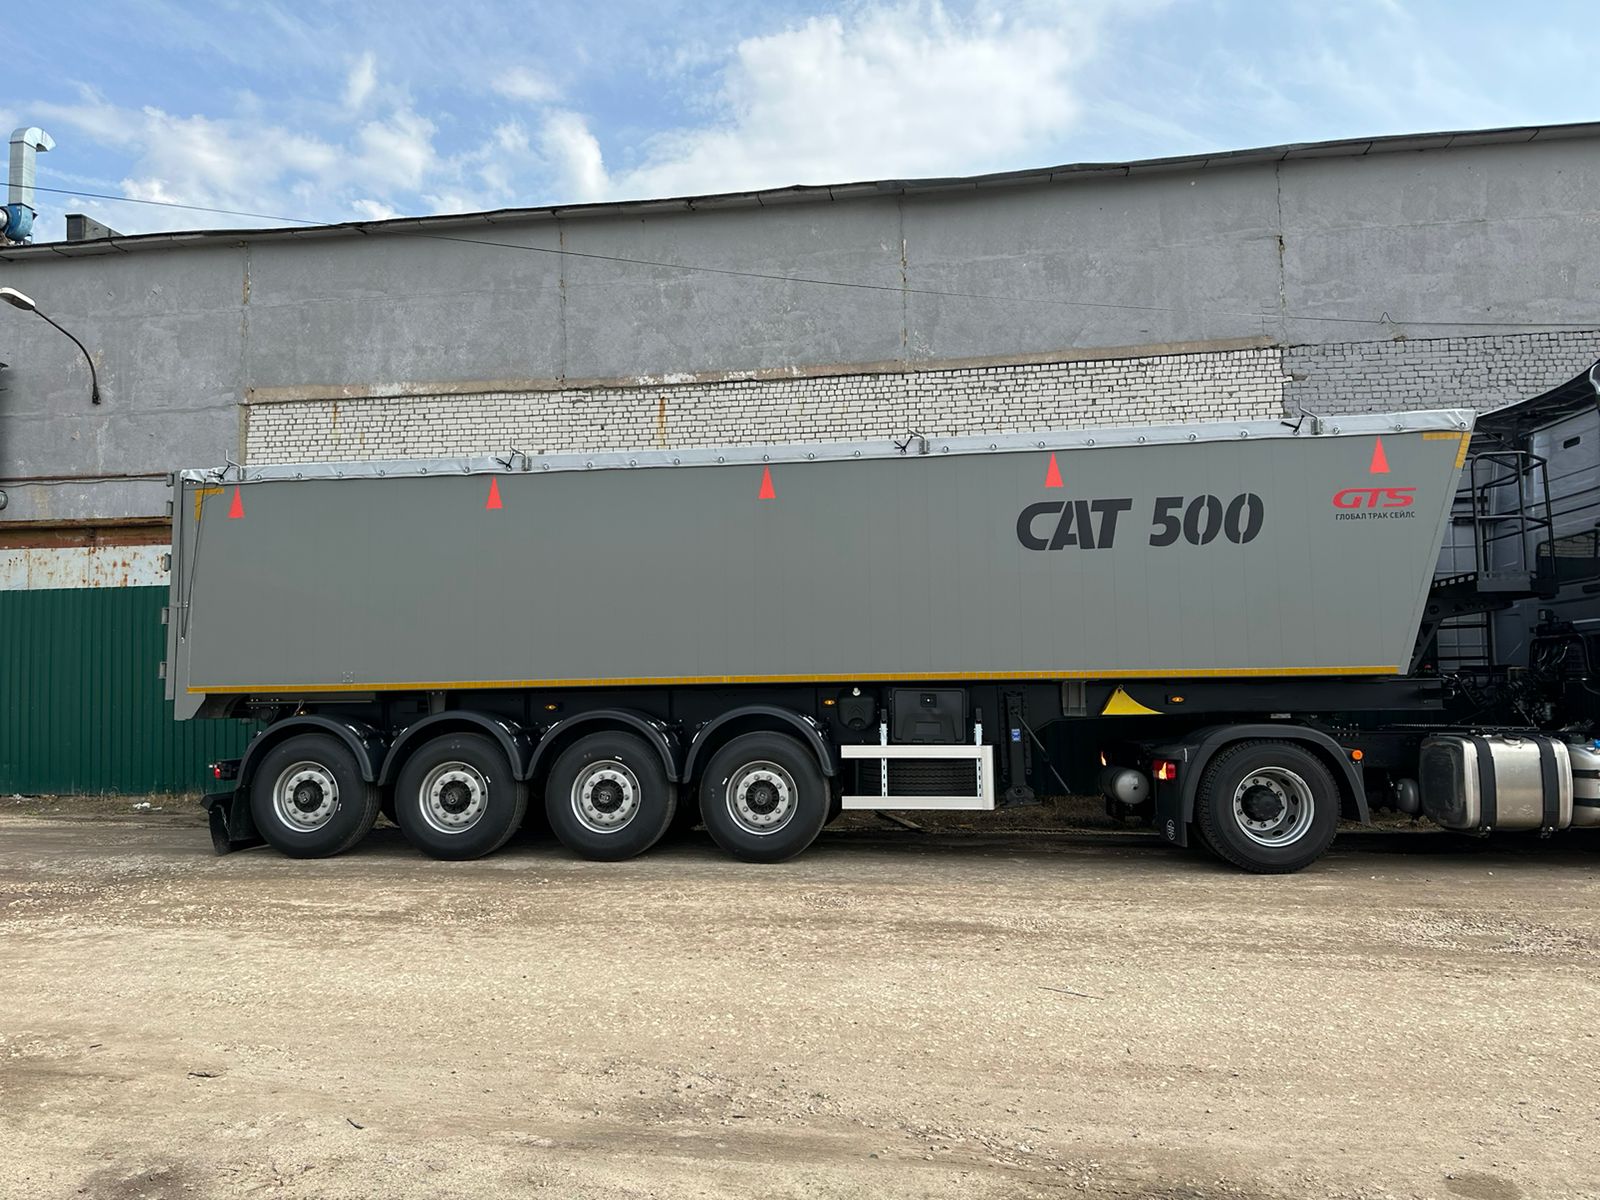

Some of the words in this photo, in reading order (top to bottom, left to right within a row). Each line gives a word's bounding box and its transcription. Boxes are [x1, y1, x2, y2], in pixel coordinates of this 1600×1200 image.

[1332, 487, 1417, 509] GTS
[1149, 493, 1265, 547] 500
[1335, 512, 1367, 521] ГЛОБАЛ
[1368, 511, 1389, 520] ТРАК
[1389, 510, 1416, 519] СЕЙЛС
